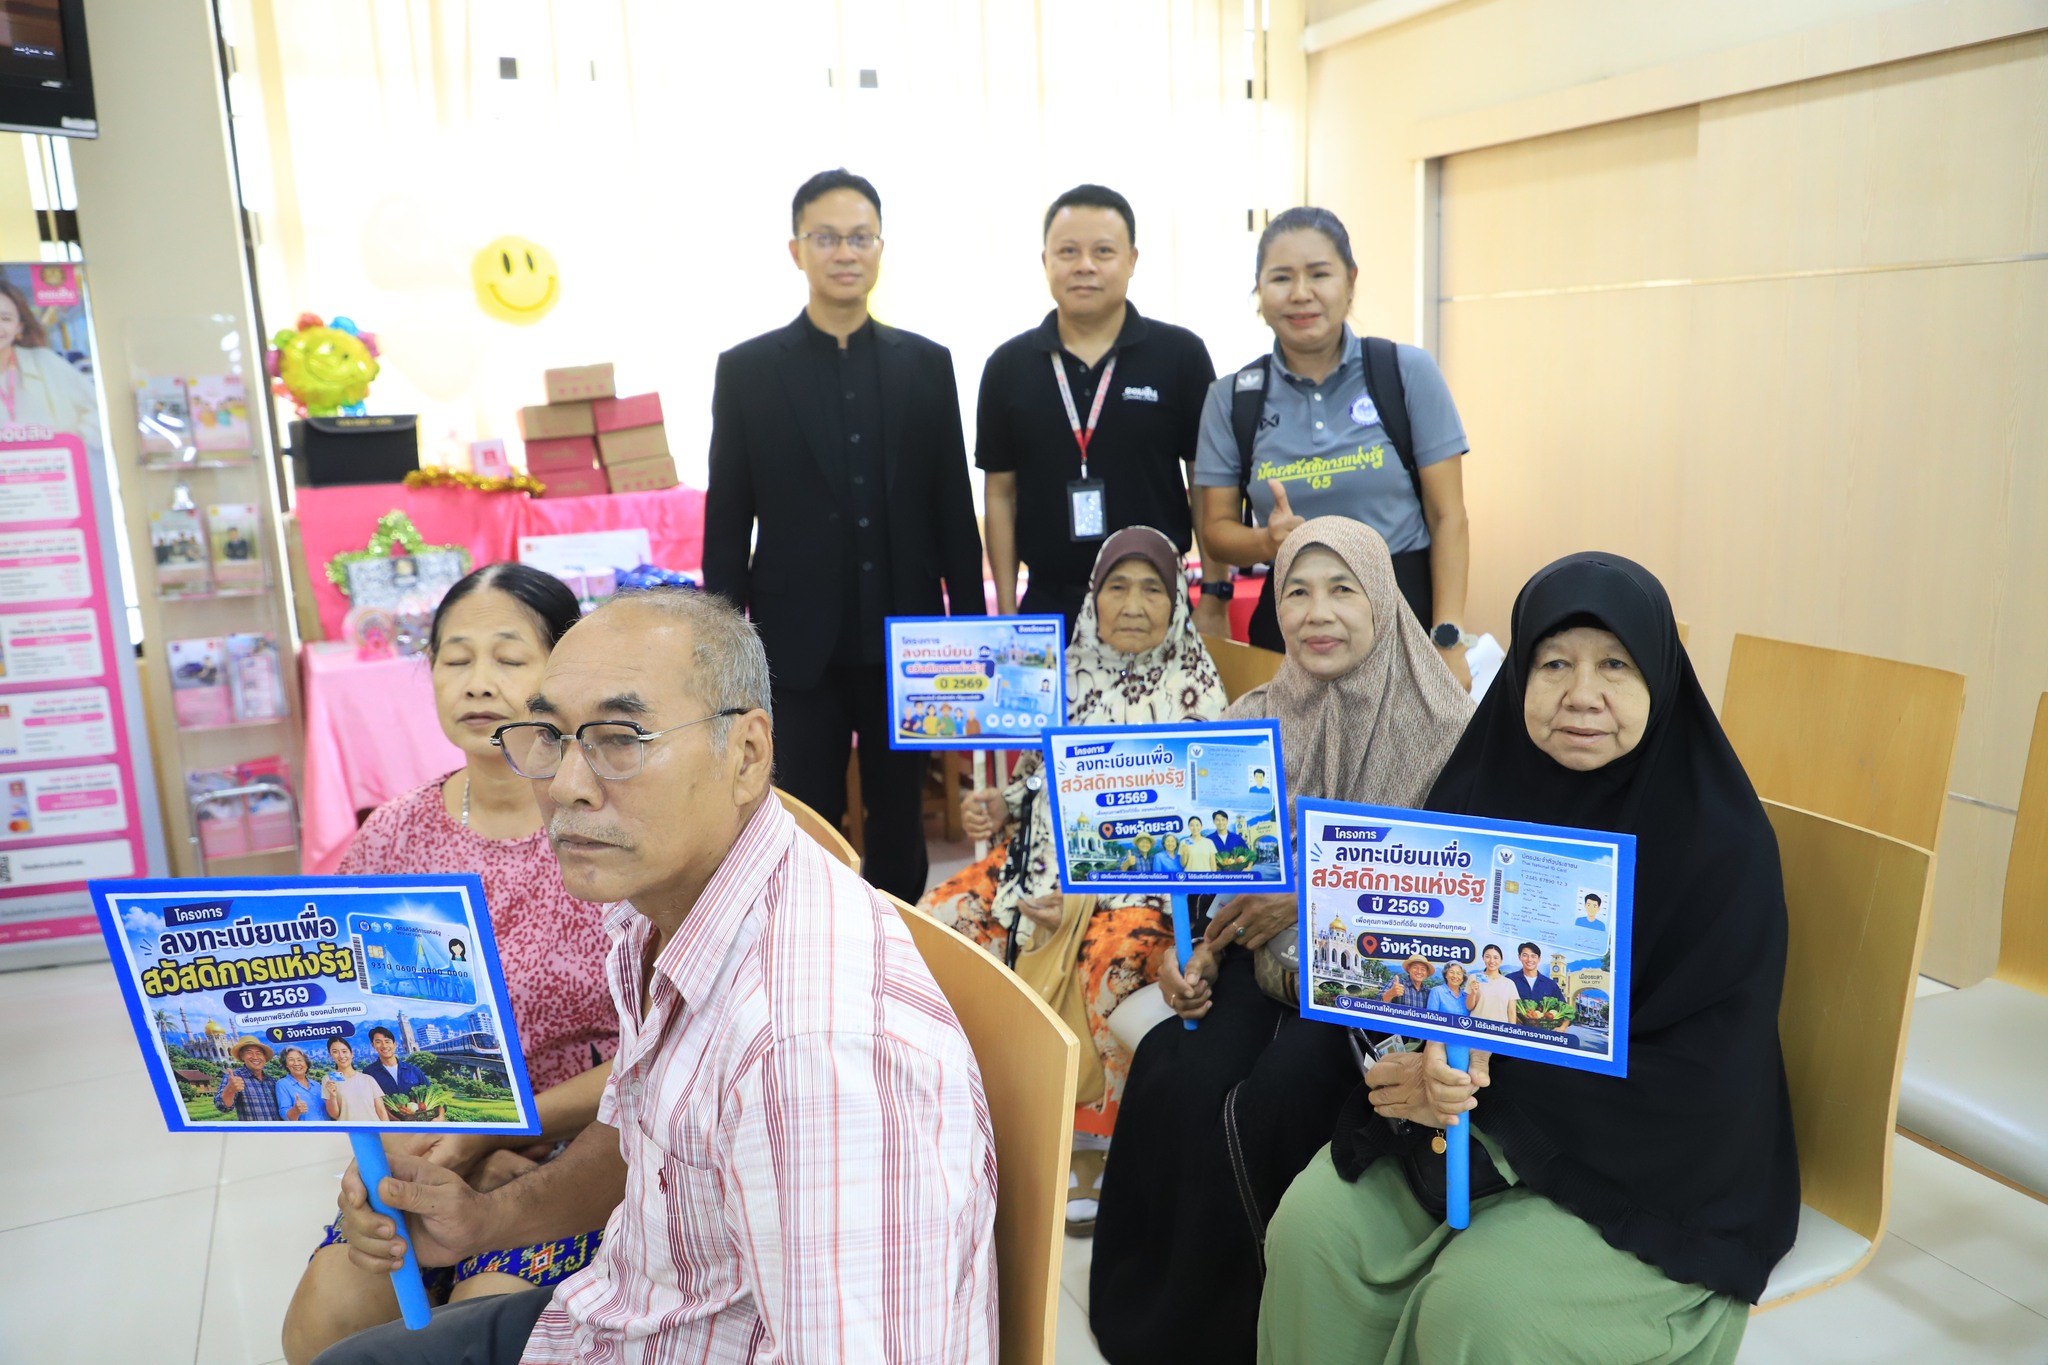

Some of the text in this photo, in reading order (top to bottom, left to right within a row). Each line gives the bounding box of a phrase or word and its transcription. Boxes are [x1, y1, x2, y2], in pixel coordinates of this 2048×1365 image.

[902, 636, 940, 645] โครงการ
[902, 644, 972, 659] ลงทะเบียน
[953, 679, 983, 689] 2569
[1074, 745, 1105, 756] โครงการ
[1076, 744, 1174, 772] ลงทะเบียนเพื่อ
[1061, 767, 1185, 793] สวัสดิการแห่งรัฐ
[1106, 792, 1148, 806] ปี 2569
[1115, 820, 1180, 836] จังหวัดยะลา
[1334, 827, 1378, 841] โครงการ
[1335, 840, 1471, 868] ลงทะเบียนเพื่อ
[1311, 865, 1486, 903] สวัสดิการแห่งรัฐ
[174, 903, 224, 921] โครงการ
[1372, 894, 1430, 915] ปี 2569
[160, 903, 337, 956] ลงทะเบียนเพื่อ
[1355, 917, 1467, 932] เพื่อคุณภาพชีวิตที่ดีขึ้น ของคนไทยทุกคน
[1380, 936, 1470, 959] จังหวัดยะลา
[144, 946, 354, 996] สวัสดิการแห่งรัฐ
[371, 961, 469, 978] 9310 0600 0000 0000
[240, 986, 309, 1009] ปี 2569
[241, 1005, 361, 1025] เพื่อคุณภาพชีวิตที่ดีขึ้น ของคนไทยทุกคน
[1353, 1000, 1448, 1023] เปิดโอกาสให้ทุกคนที่มีรายได้น้อย
[286, 1024, 343, 1039] จังหวัดยะลา
[1475, 1021, 1569, 1045] ได้รับสิทธิ์สวัสดิการจากภาครัฐ
